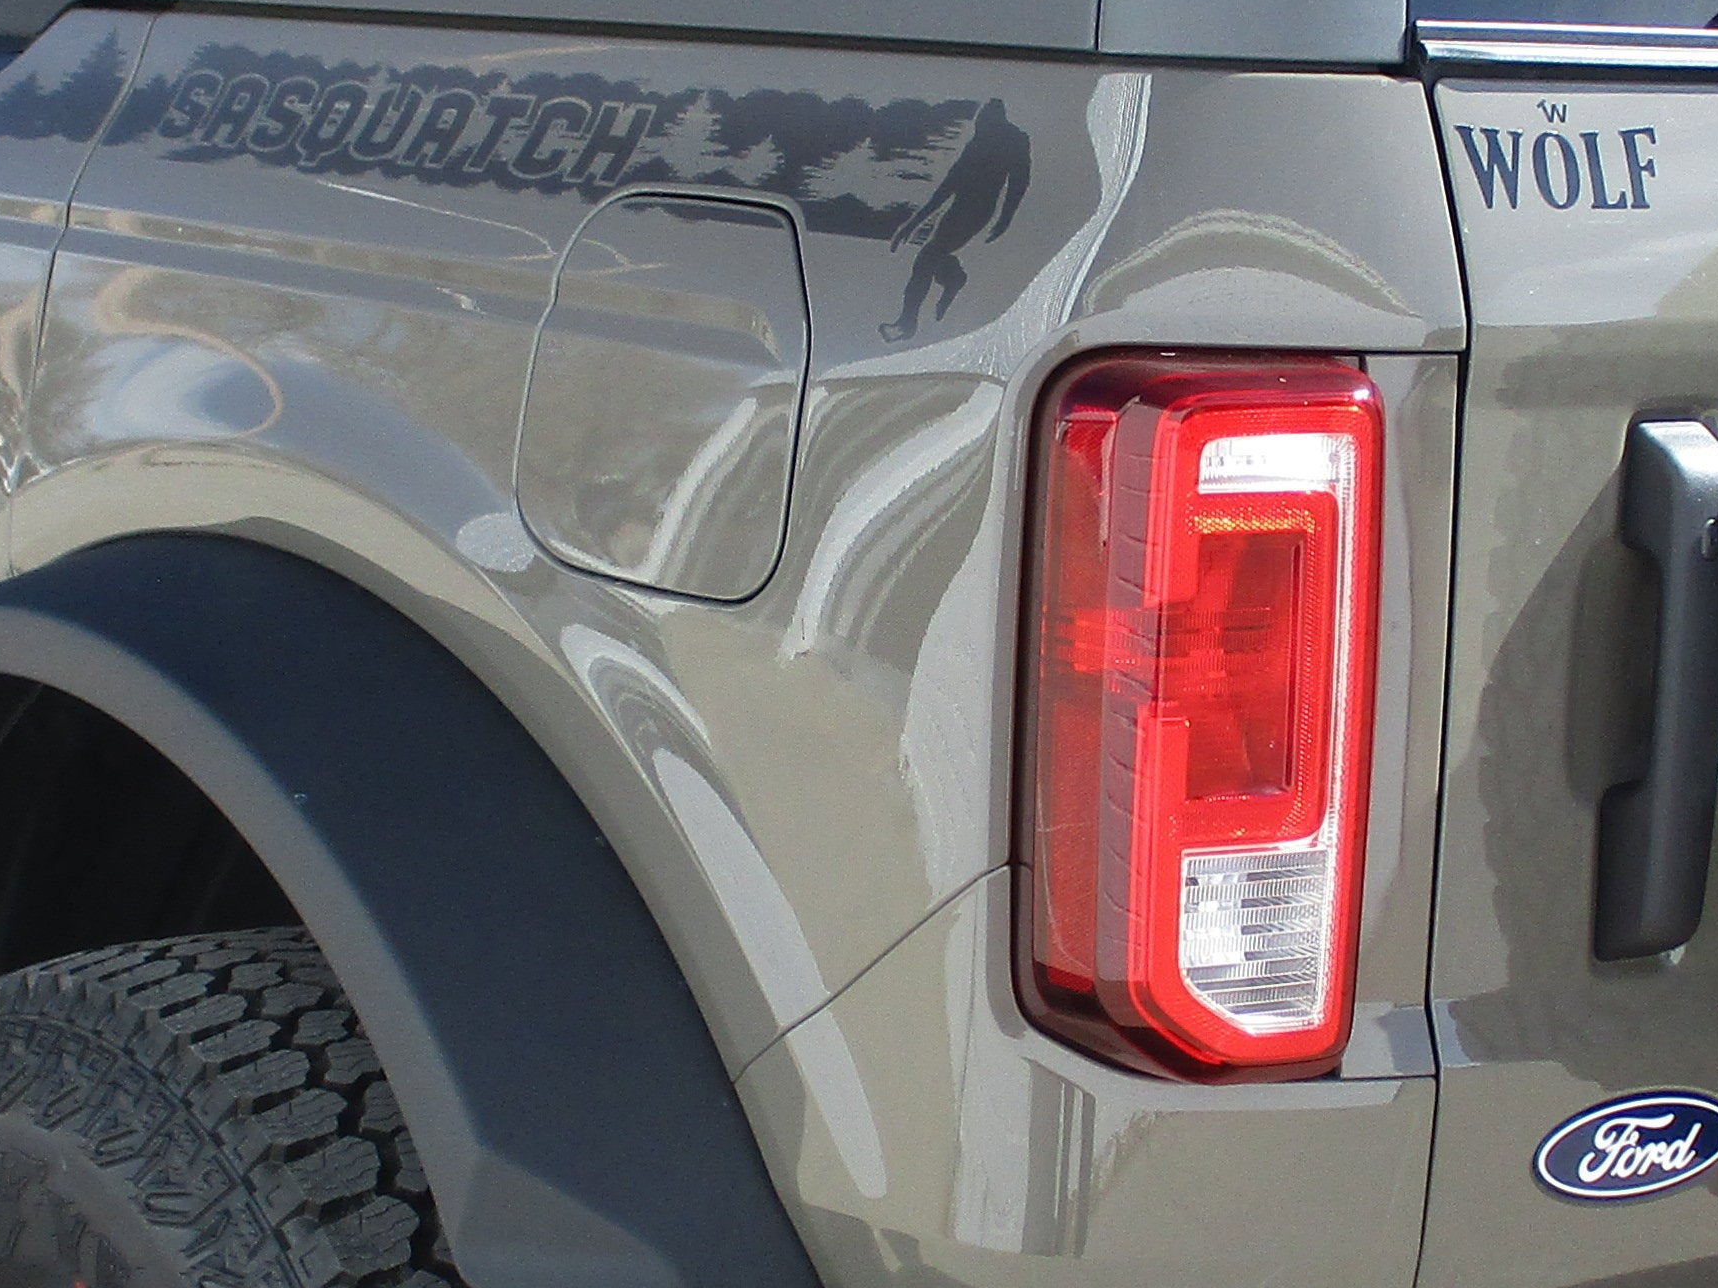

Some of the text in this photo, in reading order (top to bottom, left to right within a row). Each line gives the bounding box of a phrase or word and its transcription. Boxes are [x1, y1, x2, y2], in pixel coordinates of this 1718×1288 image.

[164, 68, 656, 186] SASQUATCH
[1453, 124, 1657, 210] WOLF
[1578, 1113, 1703, 1183] Ford
